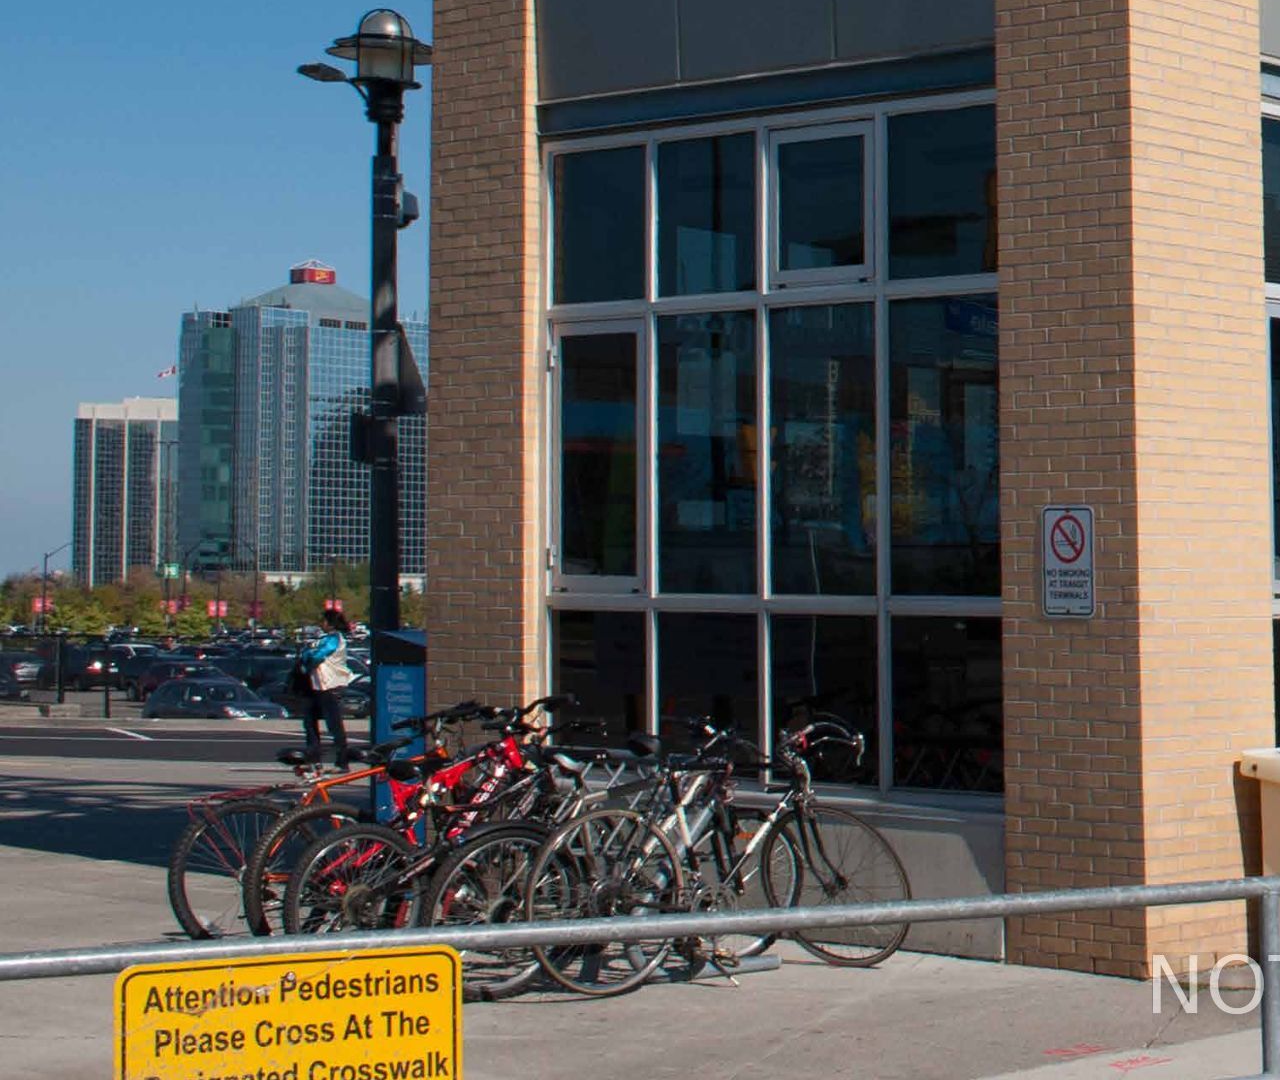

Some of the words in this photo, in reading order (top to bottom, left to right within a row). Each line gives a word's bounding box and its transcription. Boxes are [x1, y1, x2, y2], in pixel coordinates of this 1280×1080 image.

[143, 981, 271, 1014] Attention
[280, 970, 439, 1003] Pedestrians
[154, 1029, 246, 1058] Please
[255, 1020, 335, 1048] Cross
[343, 1014, 373, 1041] At
[382, 1011, 431, 1037] The
[308, 1051, 449, 1080] Crosswalk
